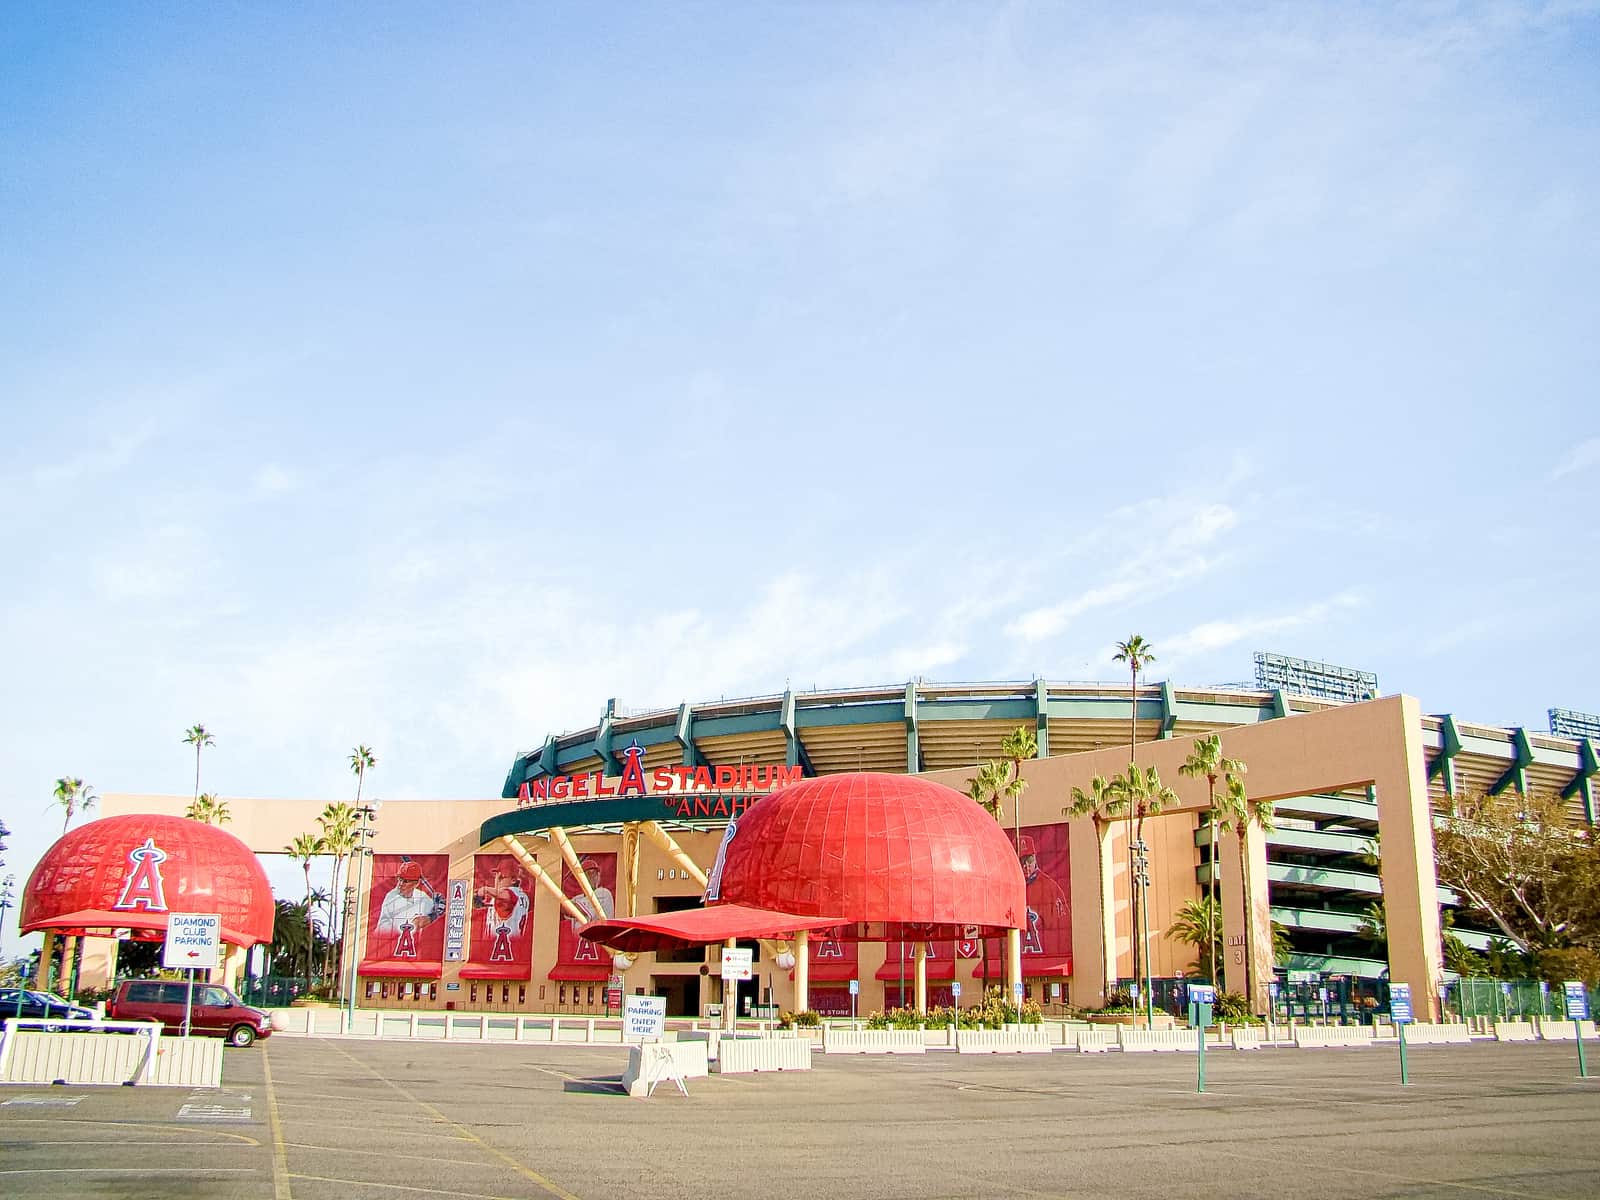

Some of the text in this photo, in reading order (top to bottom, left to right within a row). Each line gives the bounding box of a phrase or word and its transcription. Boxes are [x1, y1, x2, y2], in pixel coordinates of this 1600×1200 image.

[517, 771, 614, 805] ANGEL
[652, 765, 803, 791] STADIUM
[657, 868, 689, 880] HOM
[173, 917, 216, 928] DIAMOND
[183, 927, 207, 937] CLUB
[174, 936, 213, 946] PARKING
[628, 1007, 662, 1016] PARKING
[632, 1025, 654, 1034] HERE
